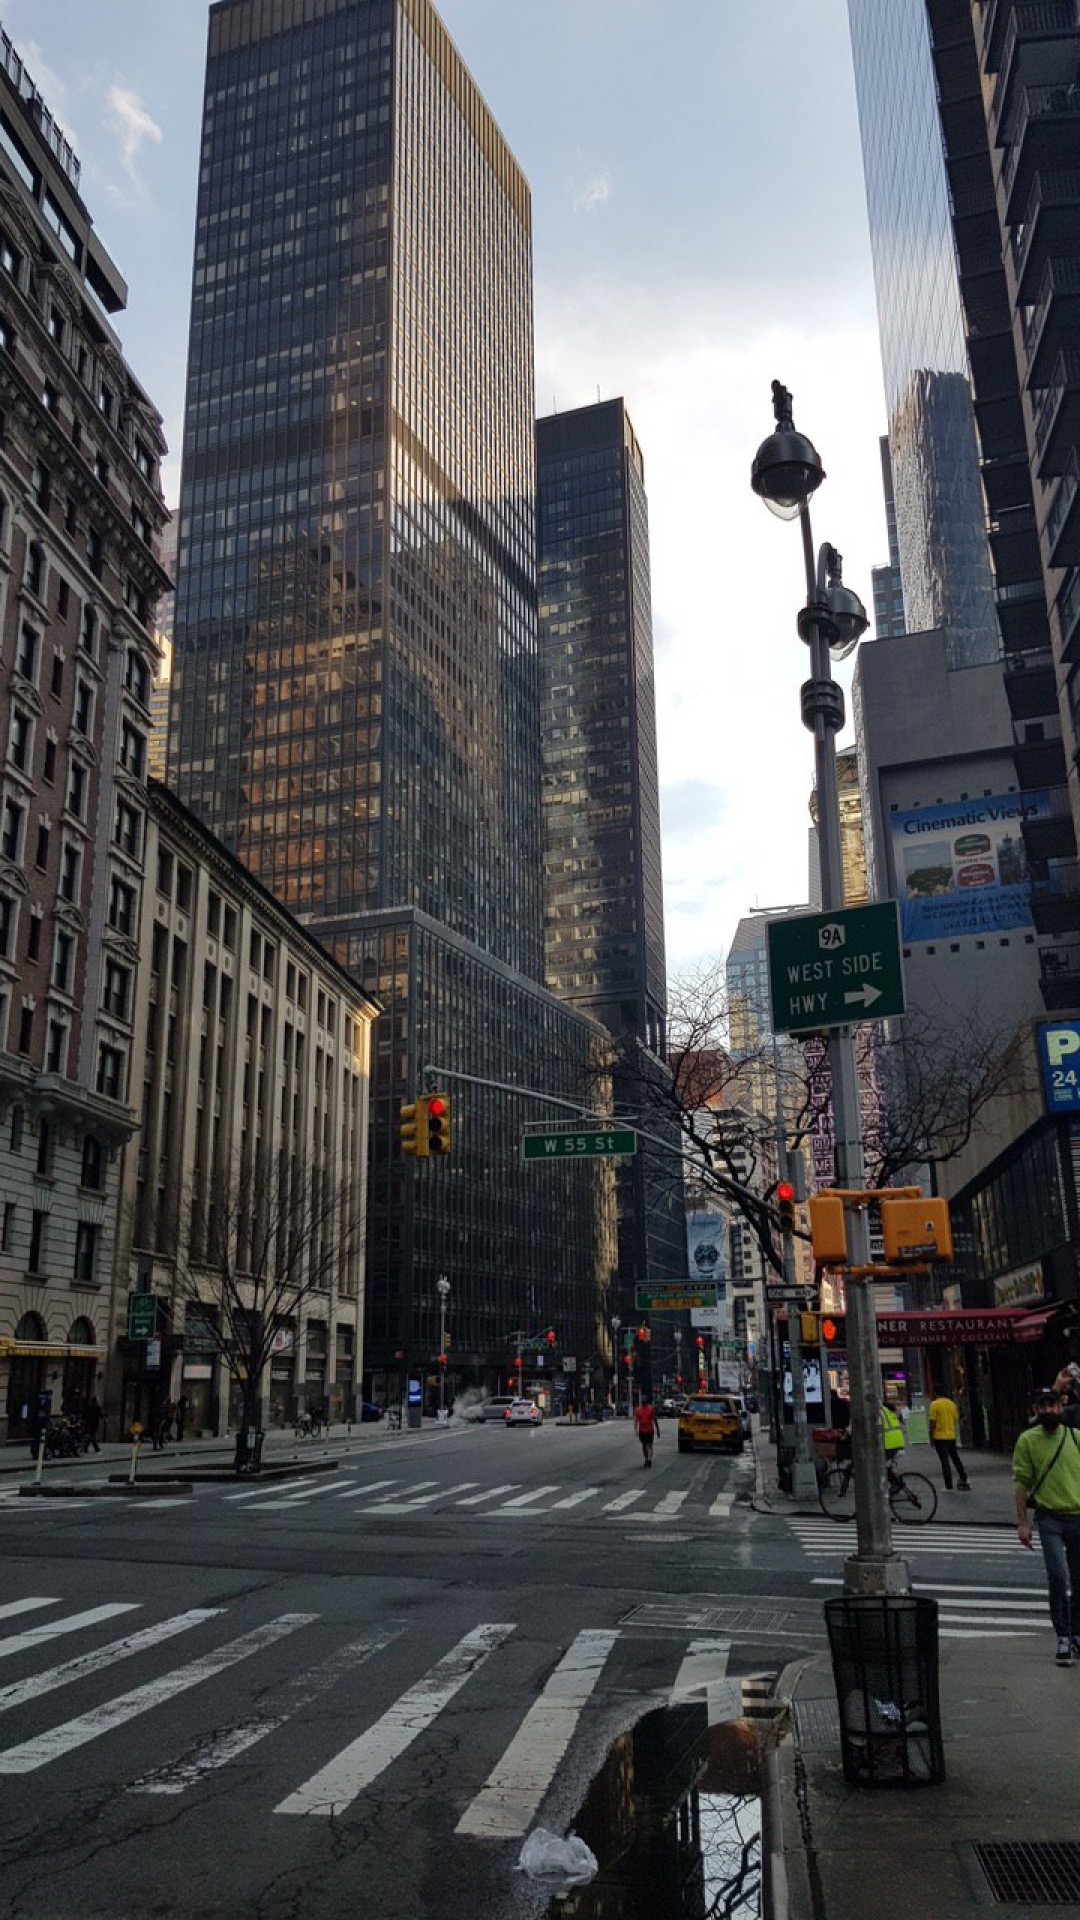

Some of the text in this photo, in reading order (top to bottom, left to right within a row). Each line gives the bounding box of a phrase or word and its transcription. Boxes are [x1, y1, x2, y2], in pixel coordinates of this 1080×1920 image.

[904, 809, 986, 835] Cinematic
[821, 927, 842, 946] 9A
[787, 951, 883, 984] WEST SIDE
[790, 992, 828, 1015] HWY
[1046, 1030, 1080, 1066] P
[1052, 1070, 1078, 1087] 24
[543, 1136, 615, 1153] W 55 St
[877, 1317, 1016, 1333] NER RESTAURANT
